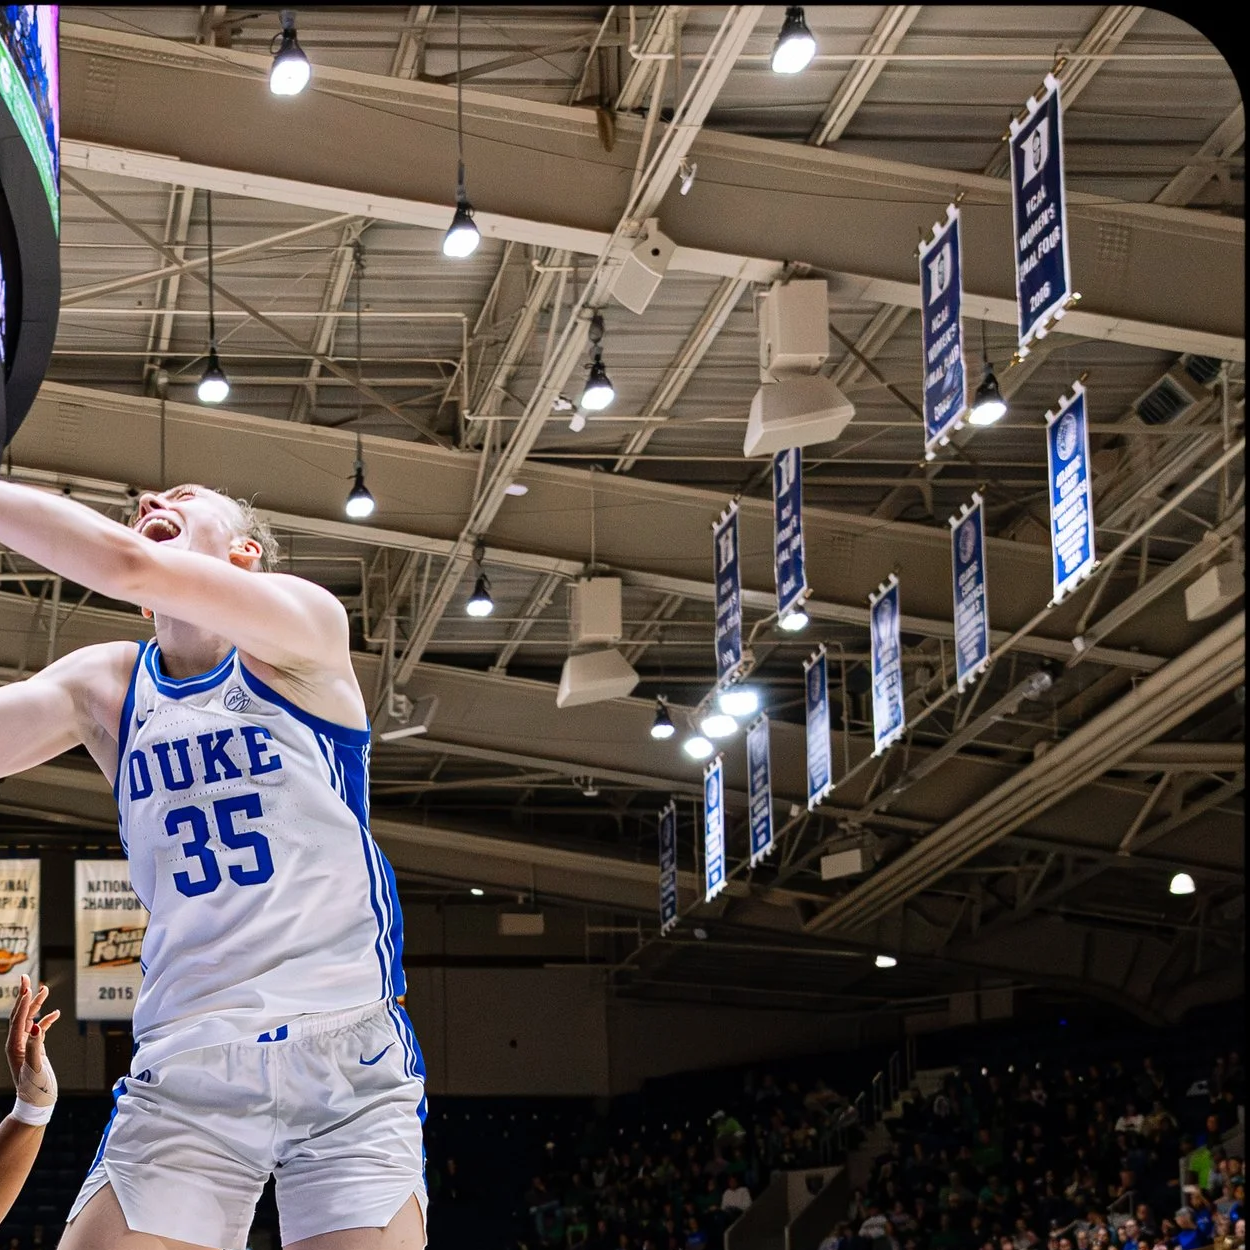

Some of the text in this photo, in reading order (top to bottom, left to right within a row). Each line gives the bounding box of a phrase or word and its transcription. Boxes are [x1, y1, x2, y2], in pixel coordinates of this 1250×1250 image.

[129, 728, 283, 801] DUKE
[165, 793, 276, 898] 35
[87, 880, 134, 893] NATIONA
[83, 896, 143, 910] CHAMPION
[99, 986, 134, 1000] 2015
